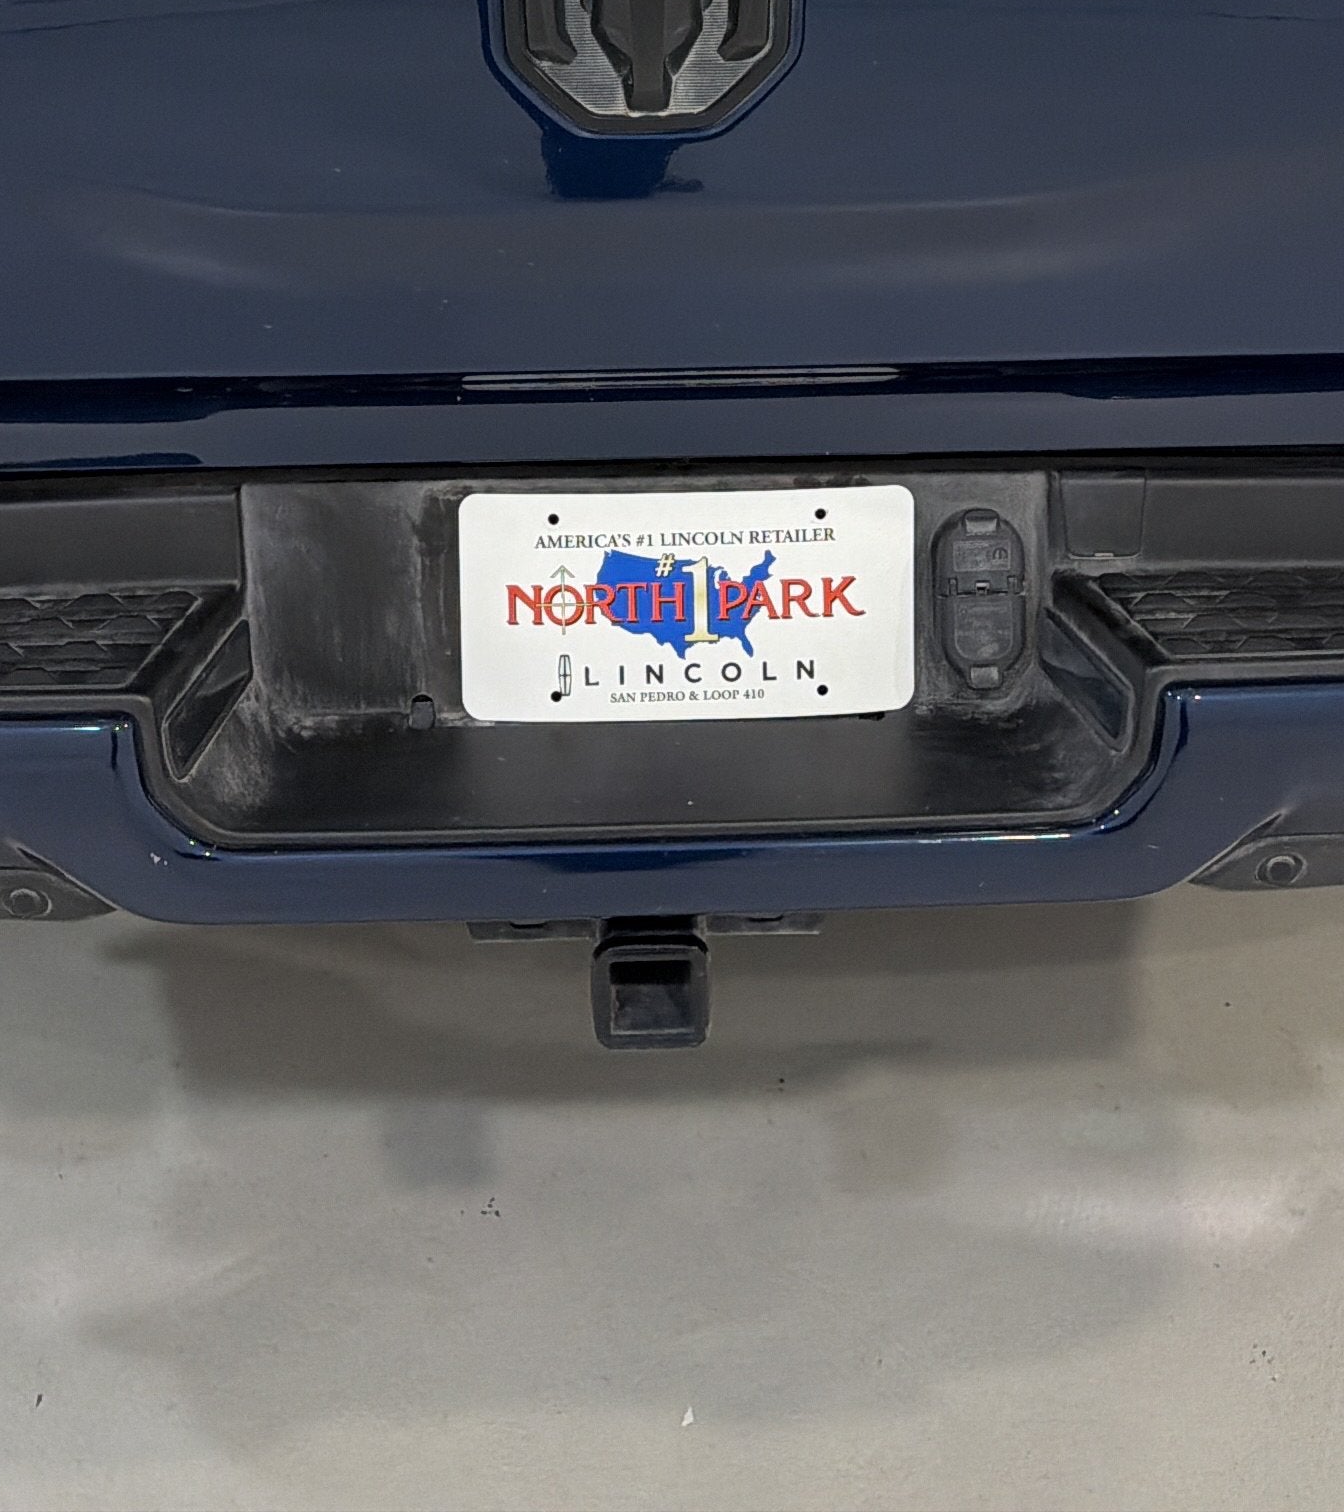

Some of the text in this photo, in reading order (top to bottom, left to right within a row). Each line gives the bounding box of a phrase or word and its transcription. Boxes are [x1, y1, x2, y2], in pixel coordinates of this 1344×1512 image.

[535, 527, 836, 550] AMERICA'S #1 LINCOLN RETAILER
[506, 581, 686, 626] NORTH
[718, 575, 867, 620] PARK
[584, 659, 815, 687] LINCOLN
[610, 688, 765, 704] SAN PEDRO & LOOP 410
